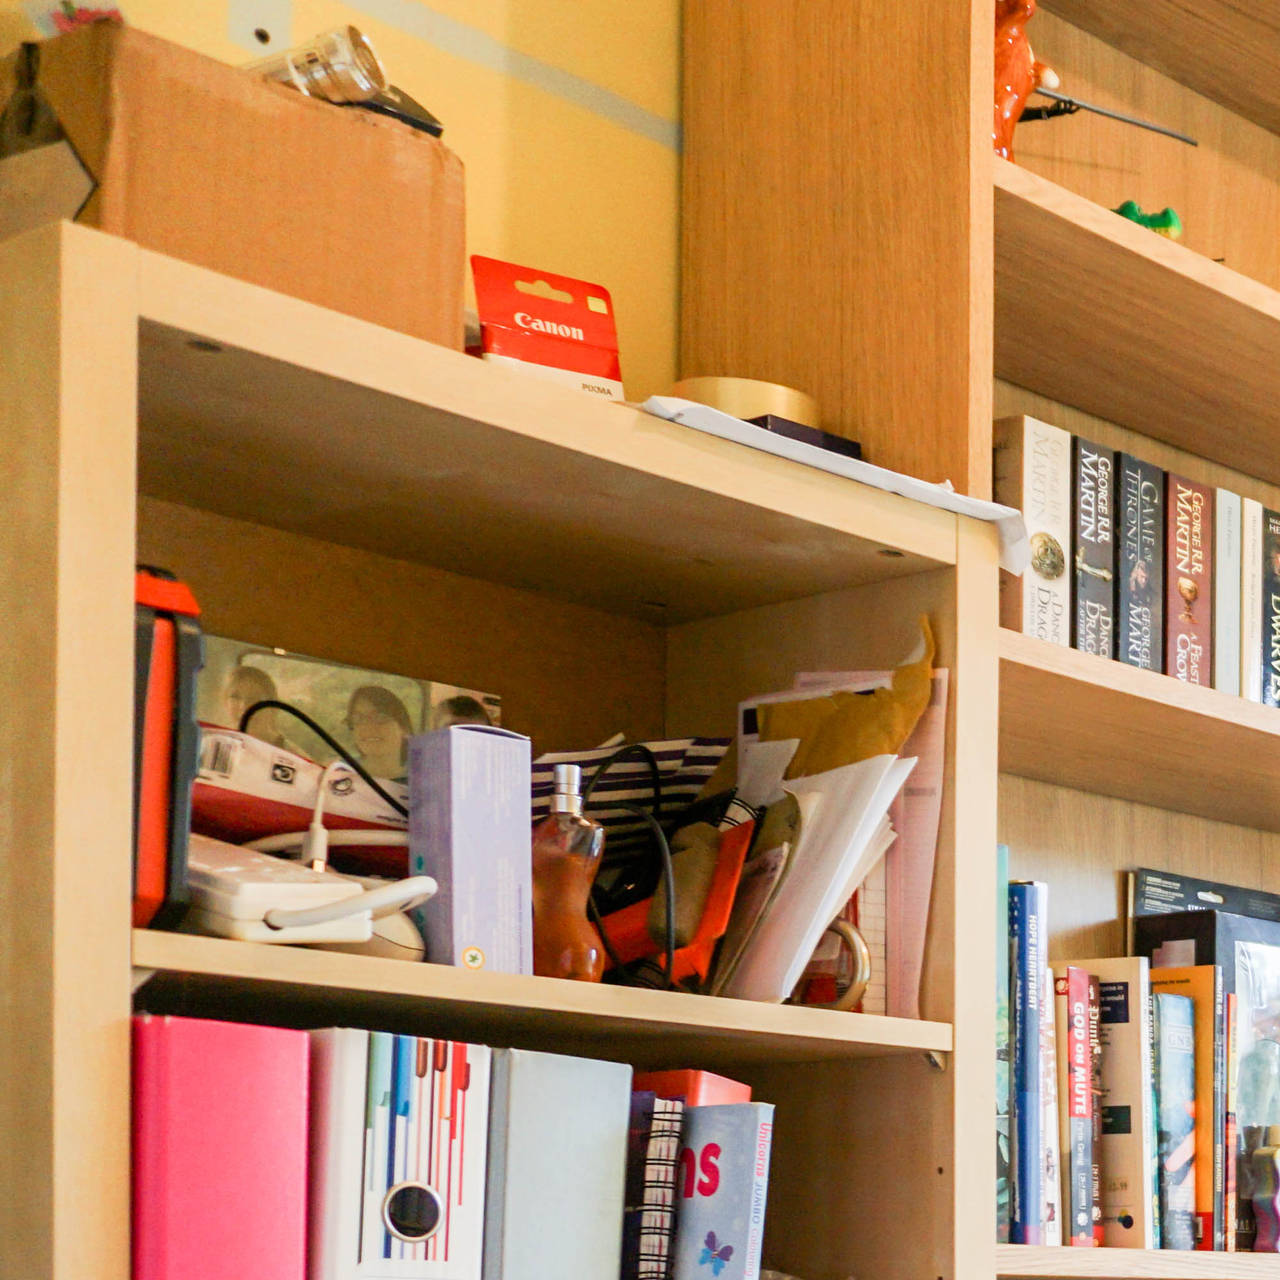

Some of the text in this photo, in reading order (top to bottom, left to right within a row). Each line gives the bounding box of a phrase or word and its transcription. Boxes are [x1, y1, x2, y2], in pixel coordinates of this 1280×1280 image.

[514, 312, 584, 341] Canon
[1081, 448, 1098, 545] MARTIN
[1097, 456, 1111, 514] GEORGE
[1141, 481, 1158, 546] GAME
[1125, 469, 1140, 563] THRONES
[1176, 484, 1192, 575] MARTIN
[1191, 492, 1203, 547] GEORGE
[1028, 914, 1037, 945] HOPE
[1074, 1002, 1087, 1115] GOD MUTE
[756, 1121, 772, 1177] Unicorns
[752, 1182, 763, 1225] JUMBO
